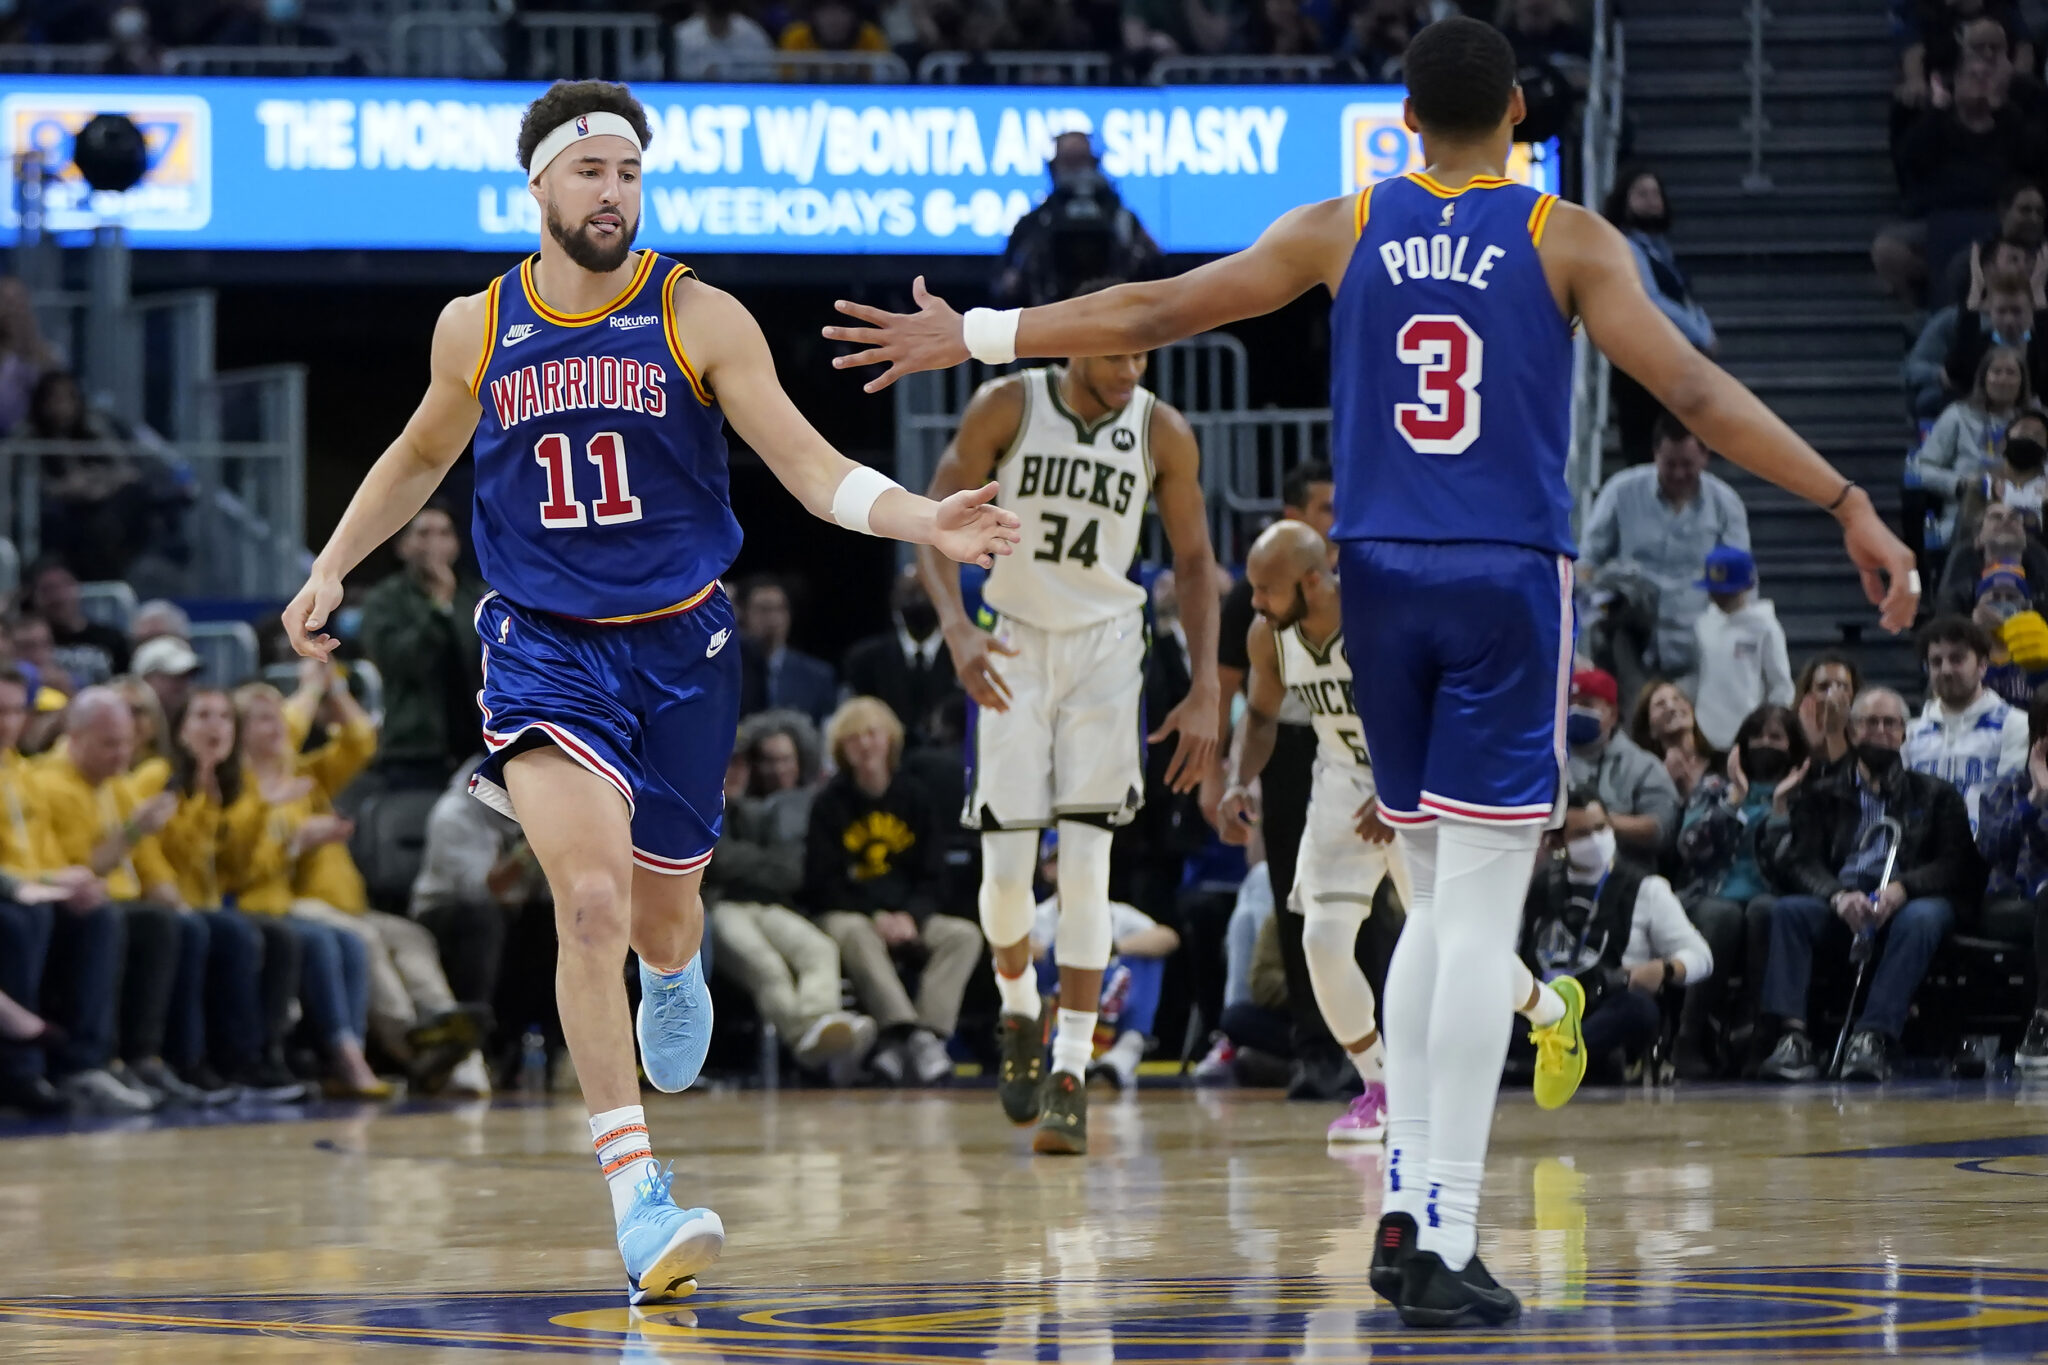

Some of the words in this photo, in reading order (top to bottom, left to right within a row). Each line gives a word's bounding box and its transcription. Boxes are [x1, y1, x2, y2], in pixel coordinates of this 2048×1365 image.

[255, 99, 356, 170] THE
[359, 100, 530, 173] MORNI
[640, 103, 751, 174] OAST
[1102, 106, 1288, 177] SHASKY
[652, 186, 916, 237] WEEKDAYS
[923, 188, 1045, 237] 6-9A
[1379, 234, 1506, 290] POOLE
[507, 323, 535, 338] NIKE
[610, 315, 658, 329] Rakuten
[490, 356, 666, 430] WARRIORS
[1394, 314, 1483, 455] 3
[534, 432, 642, 528] 11
[1017, 455, 1136, 517] BUCKS
[1034, 512, 1099, 568] 34
[710, 627, 727, 649] NIKE
